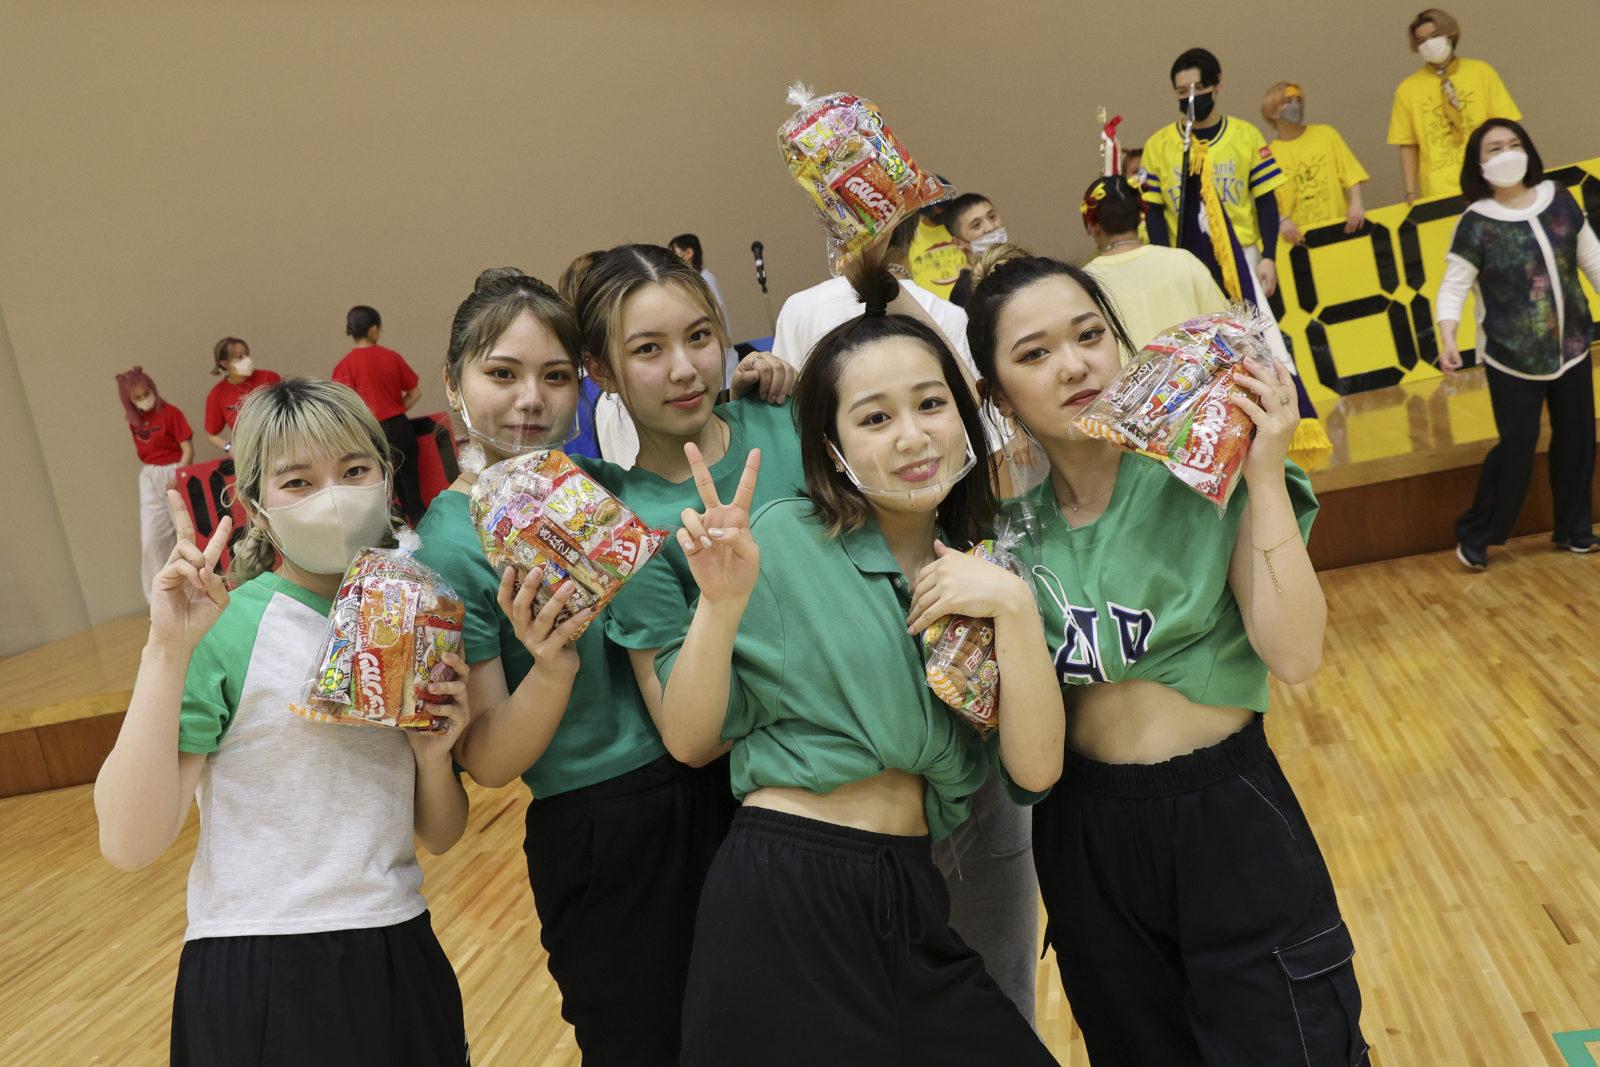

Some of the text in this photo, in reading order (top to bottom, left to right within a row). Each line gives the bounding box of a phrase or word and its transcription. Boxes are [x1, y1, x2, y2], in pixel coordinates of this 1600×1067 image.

[358, 652, 385, 718] ビッグカツ
